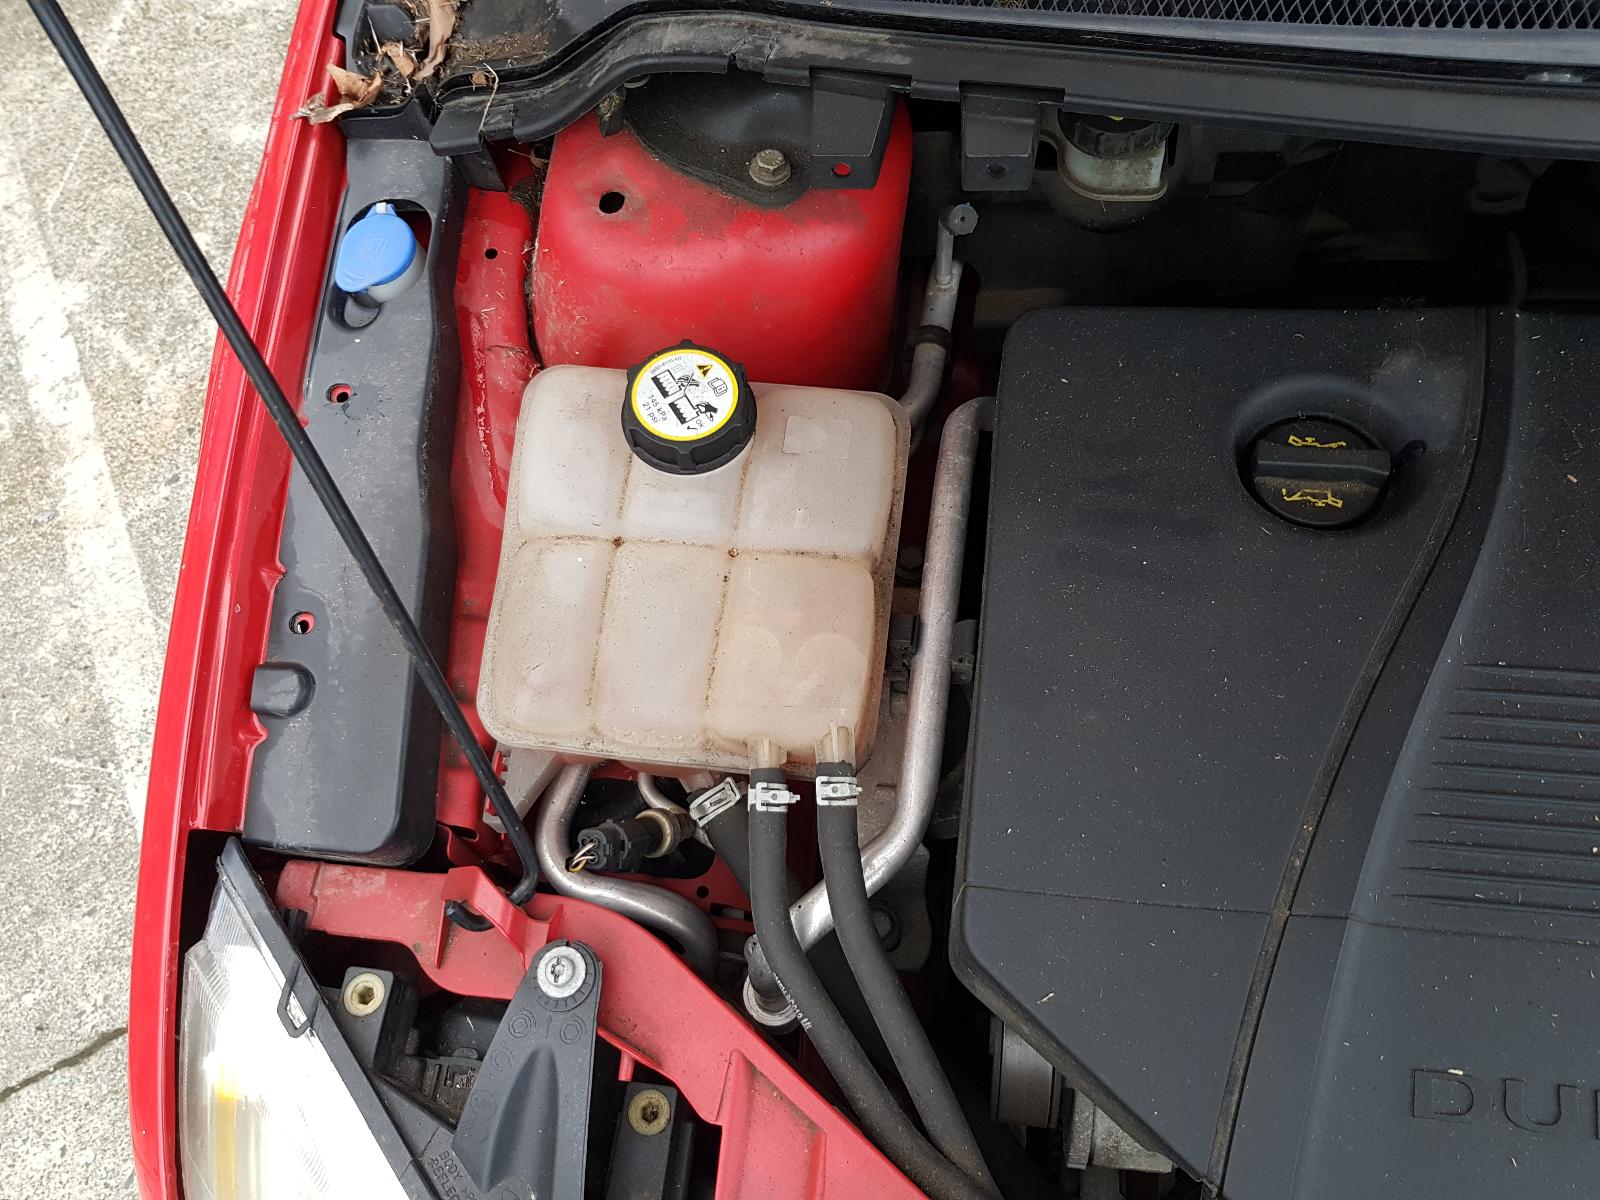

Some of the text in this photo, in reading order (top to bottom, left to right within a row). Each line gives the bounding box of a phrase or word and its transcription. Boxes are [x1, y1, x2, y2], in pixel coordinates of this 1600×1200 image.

[642, 403, 660, 424] 21 psi
[648, 394, 668, 421] 145 kPa
[695, 419, 705, 429] OK
[1411, 1069, 1600, 1141] DU
[440, 1150, 462, 1180] BODY
